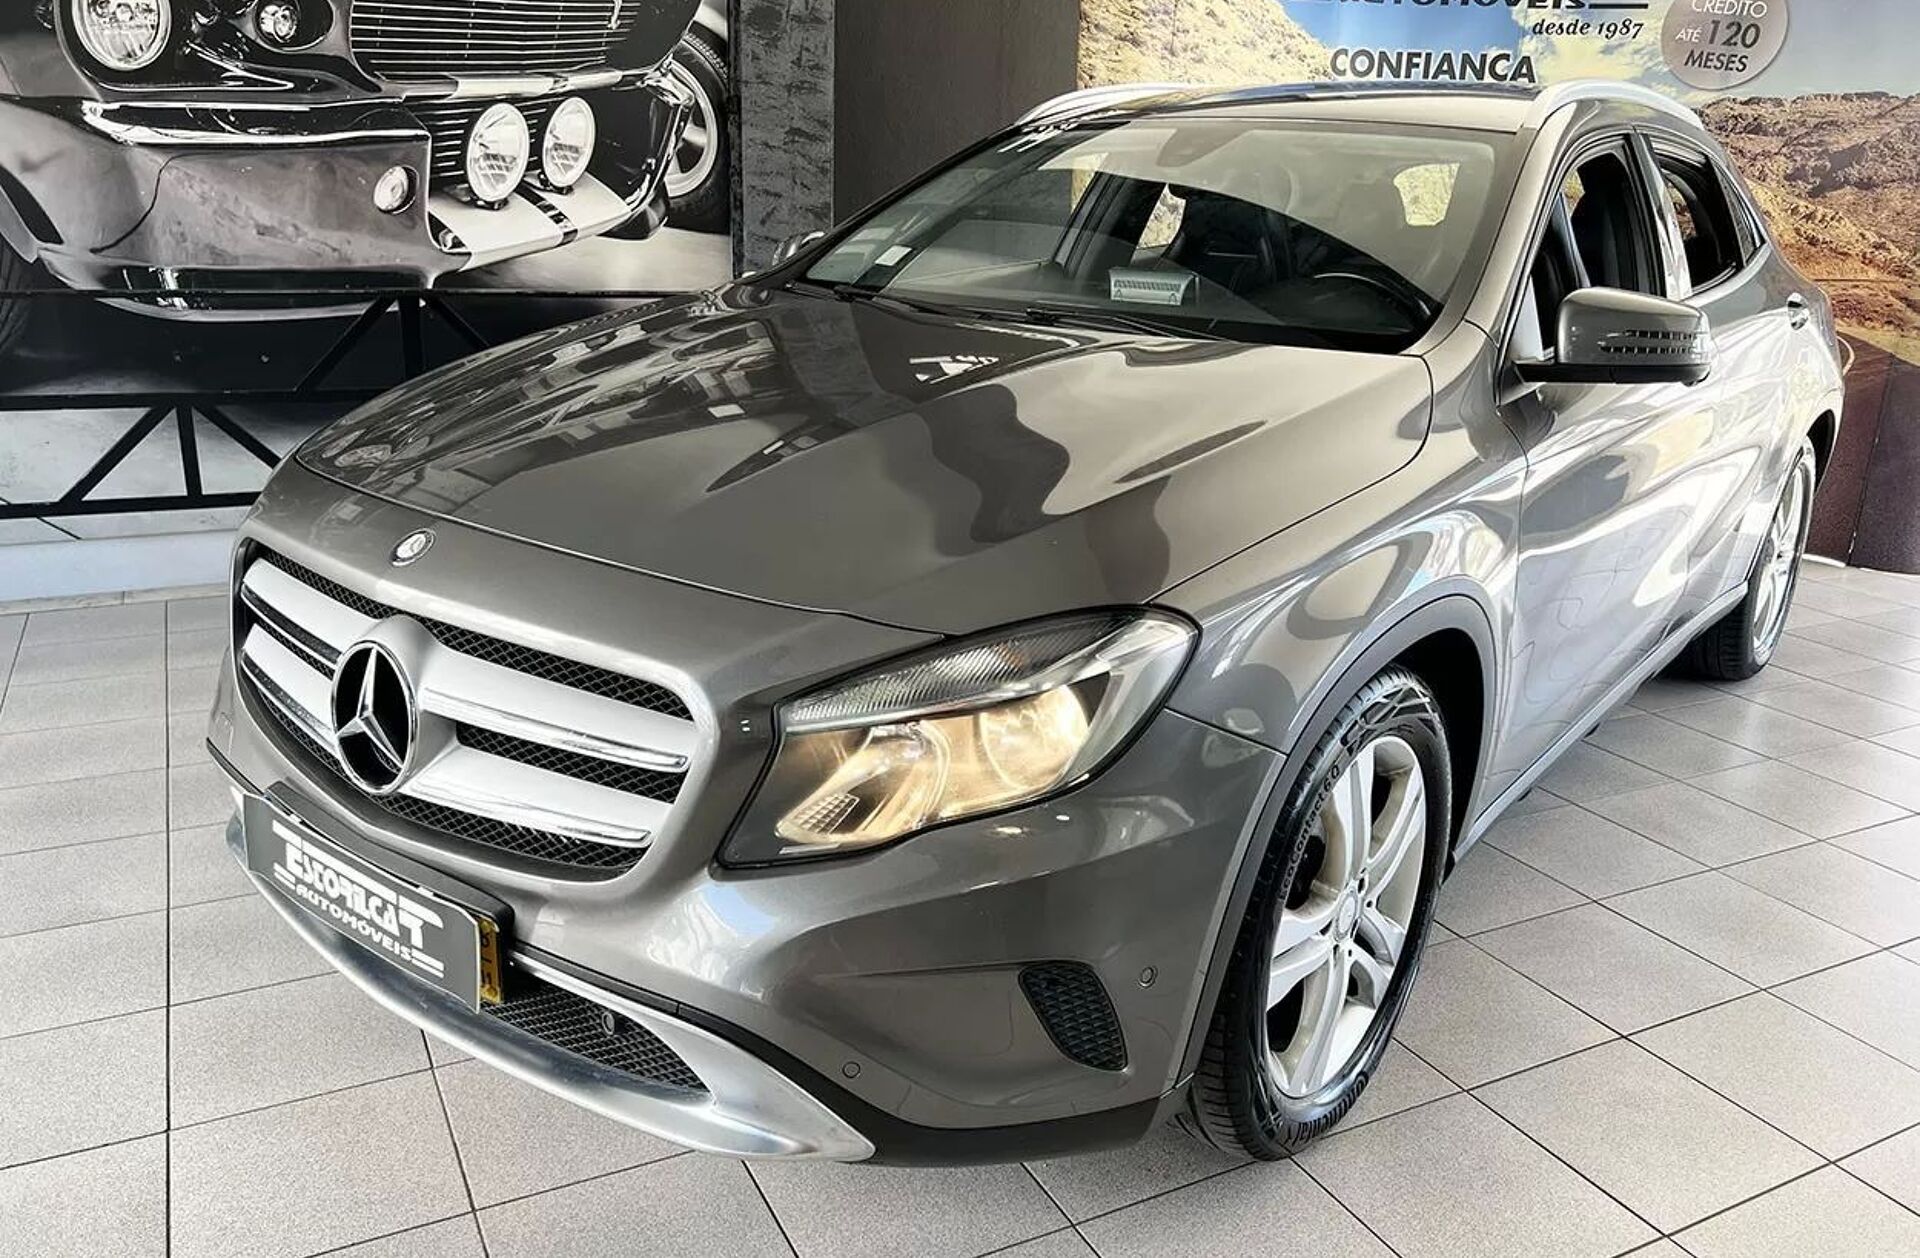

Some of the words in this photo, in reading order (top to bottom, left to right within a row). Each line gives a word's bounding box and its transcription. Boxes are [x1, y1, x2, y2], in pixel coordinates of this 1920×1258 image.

[1532, 18, 1591, 36] desde
[1598, 18, 1644, 41] 1987
[1675, 28, 1703, 43] ATÉ
[1707, 19, 1762, 49] 120
[1684, 50, 1750, 72] MESES
